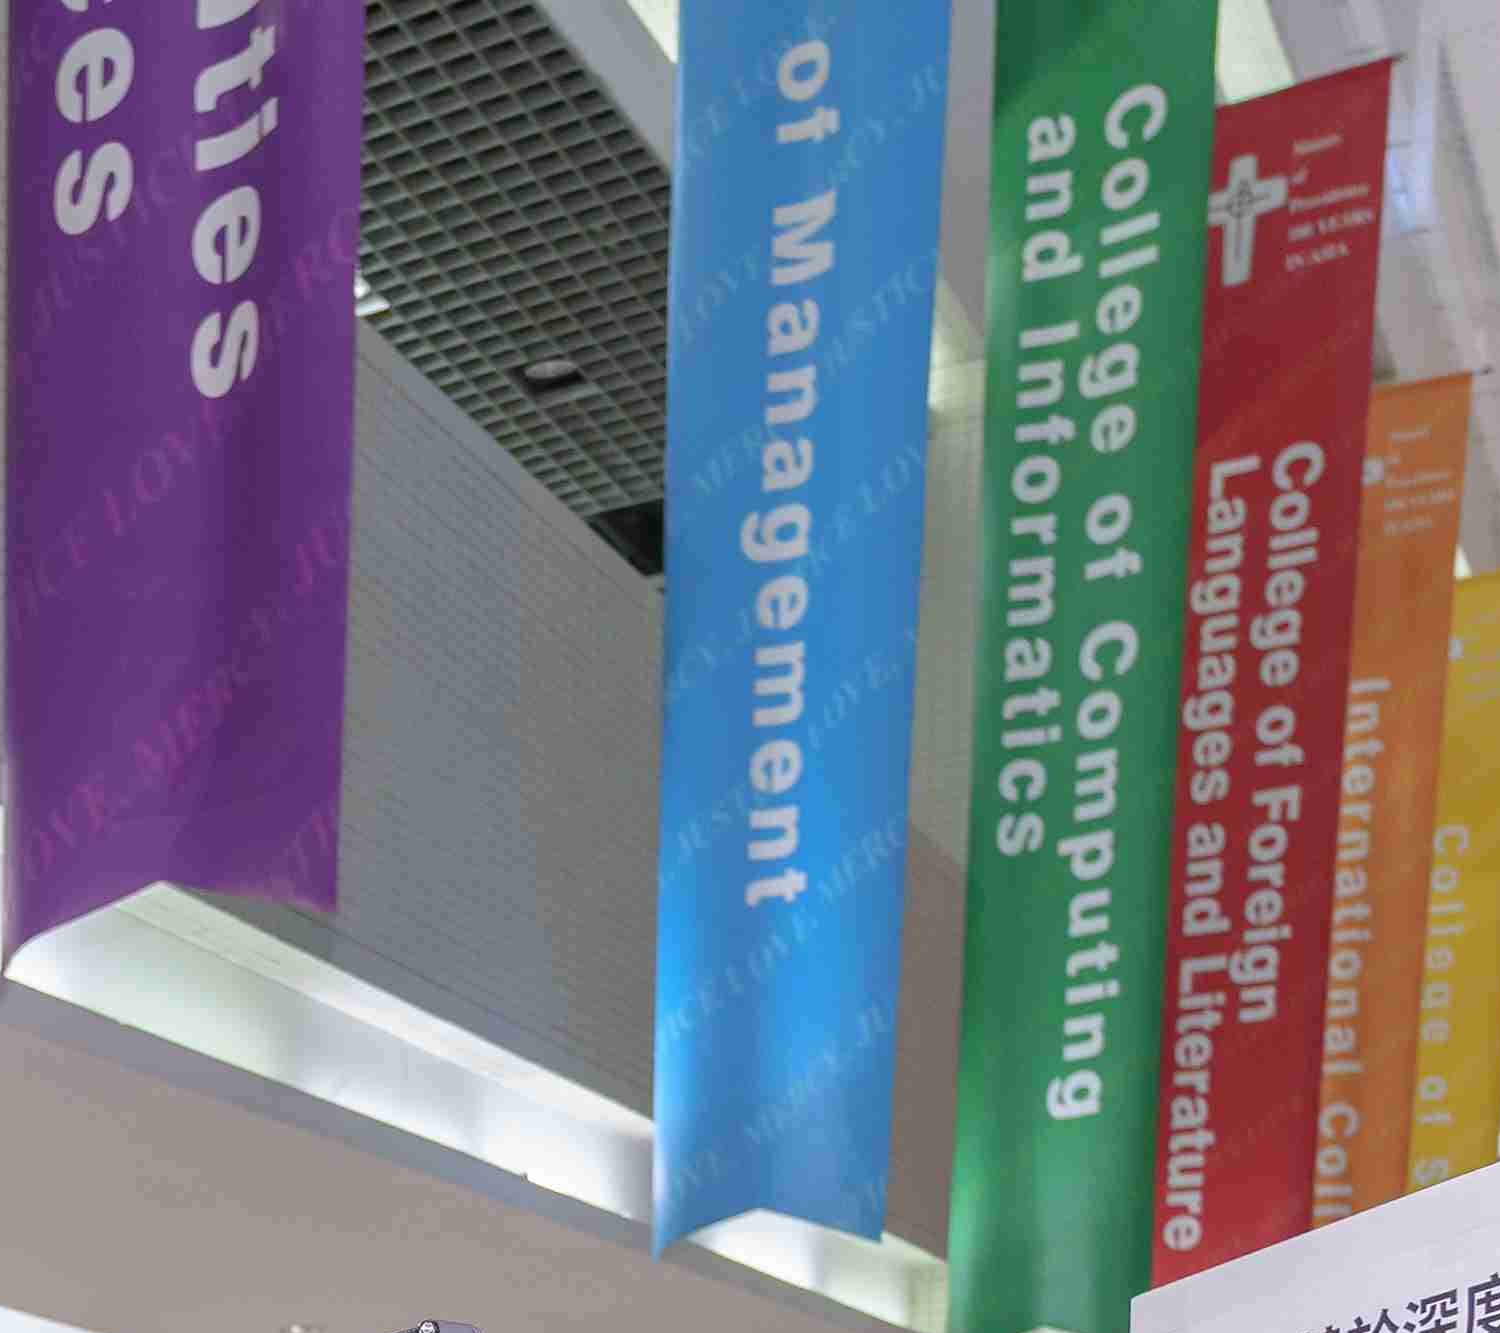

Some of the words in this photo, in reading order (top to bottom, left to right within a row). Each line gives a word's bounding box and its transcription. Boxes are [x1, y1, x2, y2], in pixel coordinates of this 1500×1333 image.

[54, 0, 134, 235] es
[775, 39, 839, 145] of
[1022, 113, 1083, 282] and
[1078, 83, 1168, 454] College
[740, 187, 836, 908] Management
[996, 319, 1080, 857] Informatics
[1084, 493, 1142, 581] of
[1182, 454, 1261, 805] Languages
[1250, 441, 1325, 687] College
[1255, 705, 1304, 767] of
[1046, 620, 1139, 1121] Computing
[1182, 823, 1231, 937] and
[1228, 784, 1301, 1025] Foreign
[1320, 676, 1391, 1076] International
[1419, 824, 1470, 1043] College
[1162, 954, 1227, 1252] Literature
[1416, 1074, 1451, 1128] of
